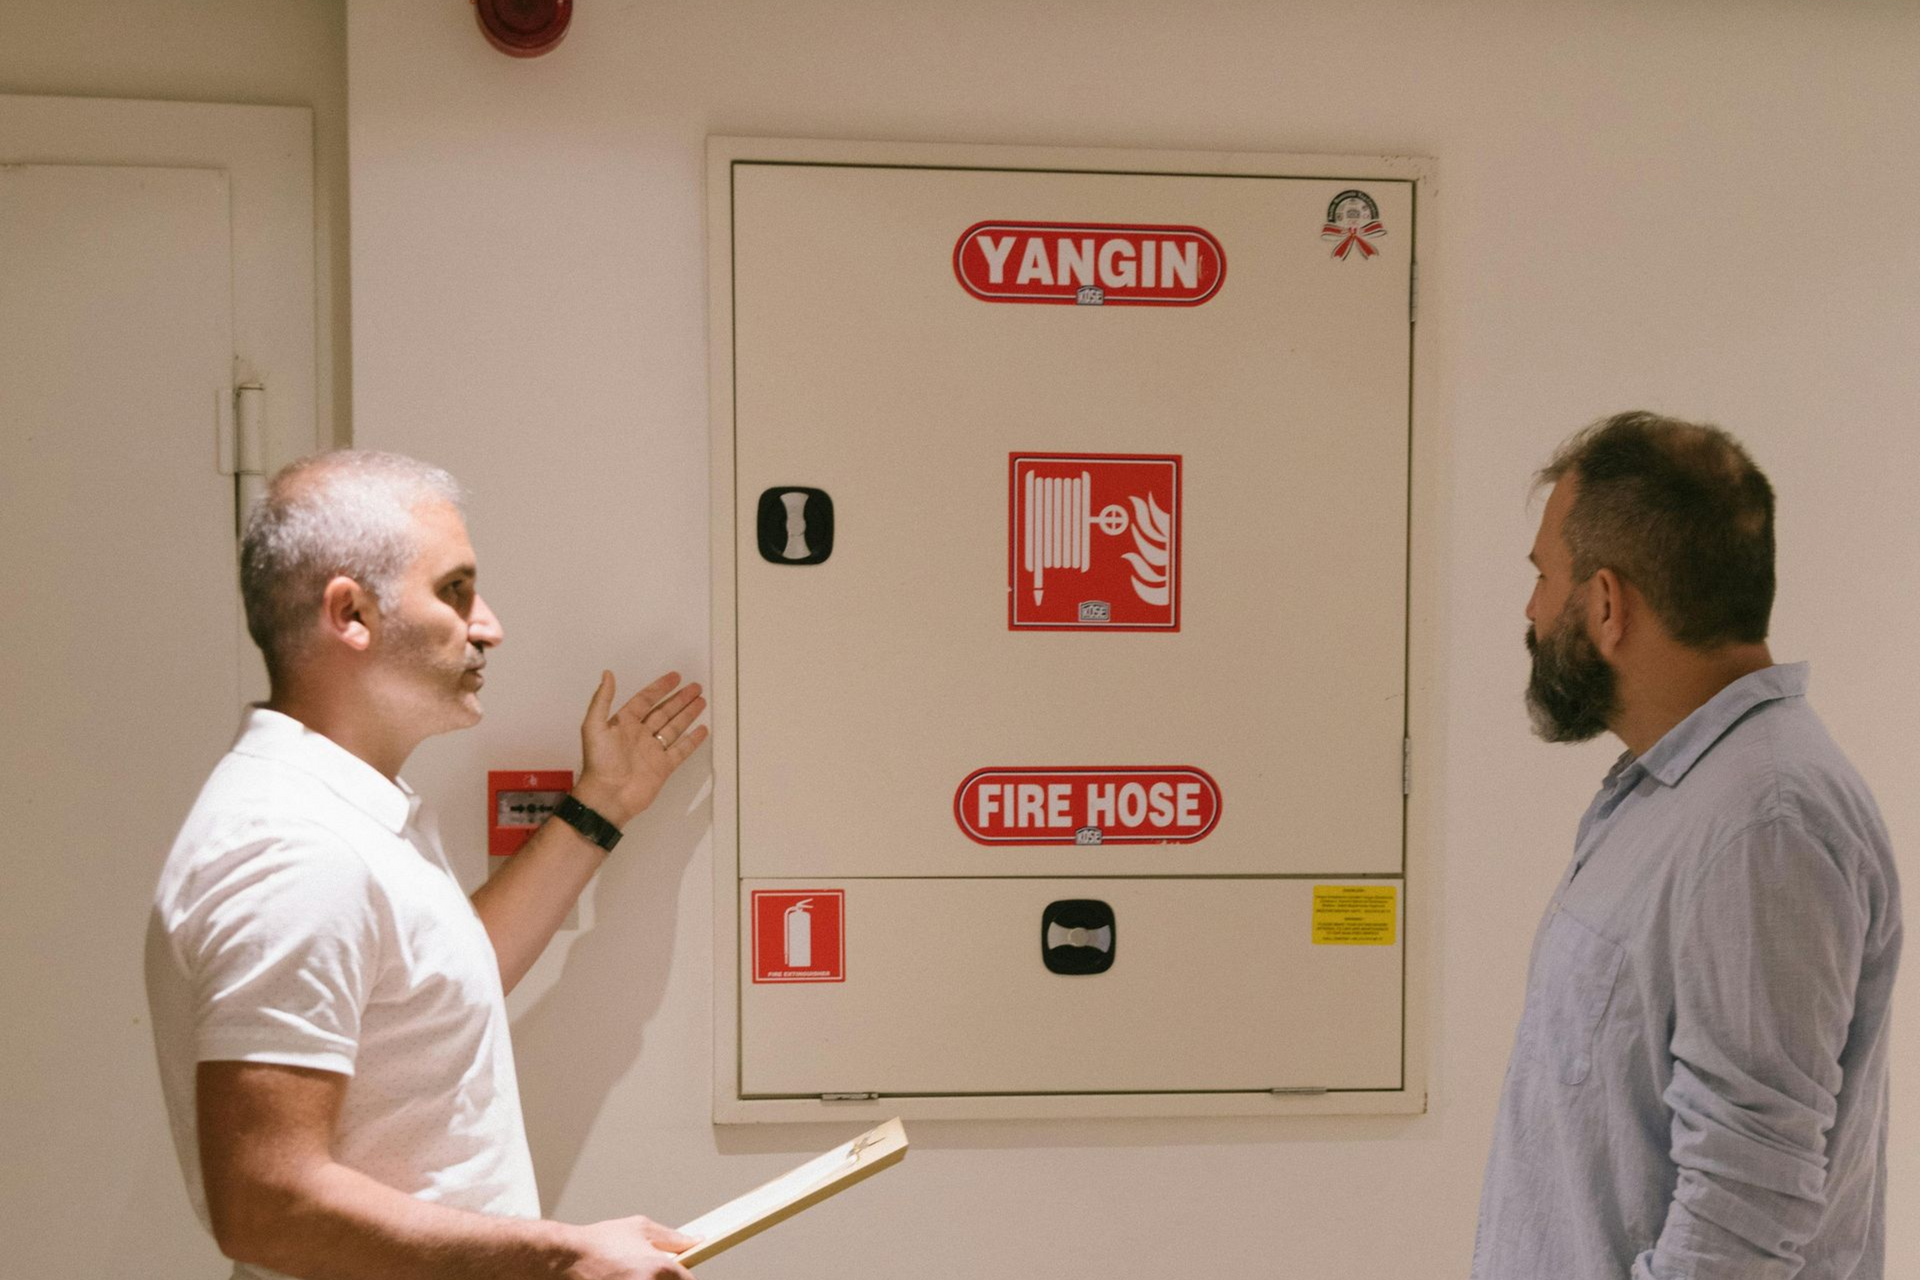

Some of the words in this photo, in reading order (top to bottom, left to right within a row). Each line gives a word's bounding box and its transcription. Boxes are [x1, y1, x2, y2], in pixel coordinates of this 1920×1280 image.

[976, 235, 1198, 289] YANGIN
[978, 783, 1073, 828] FIRE
[1087, 782, 1201, 828] HOSE
